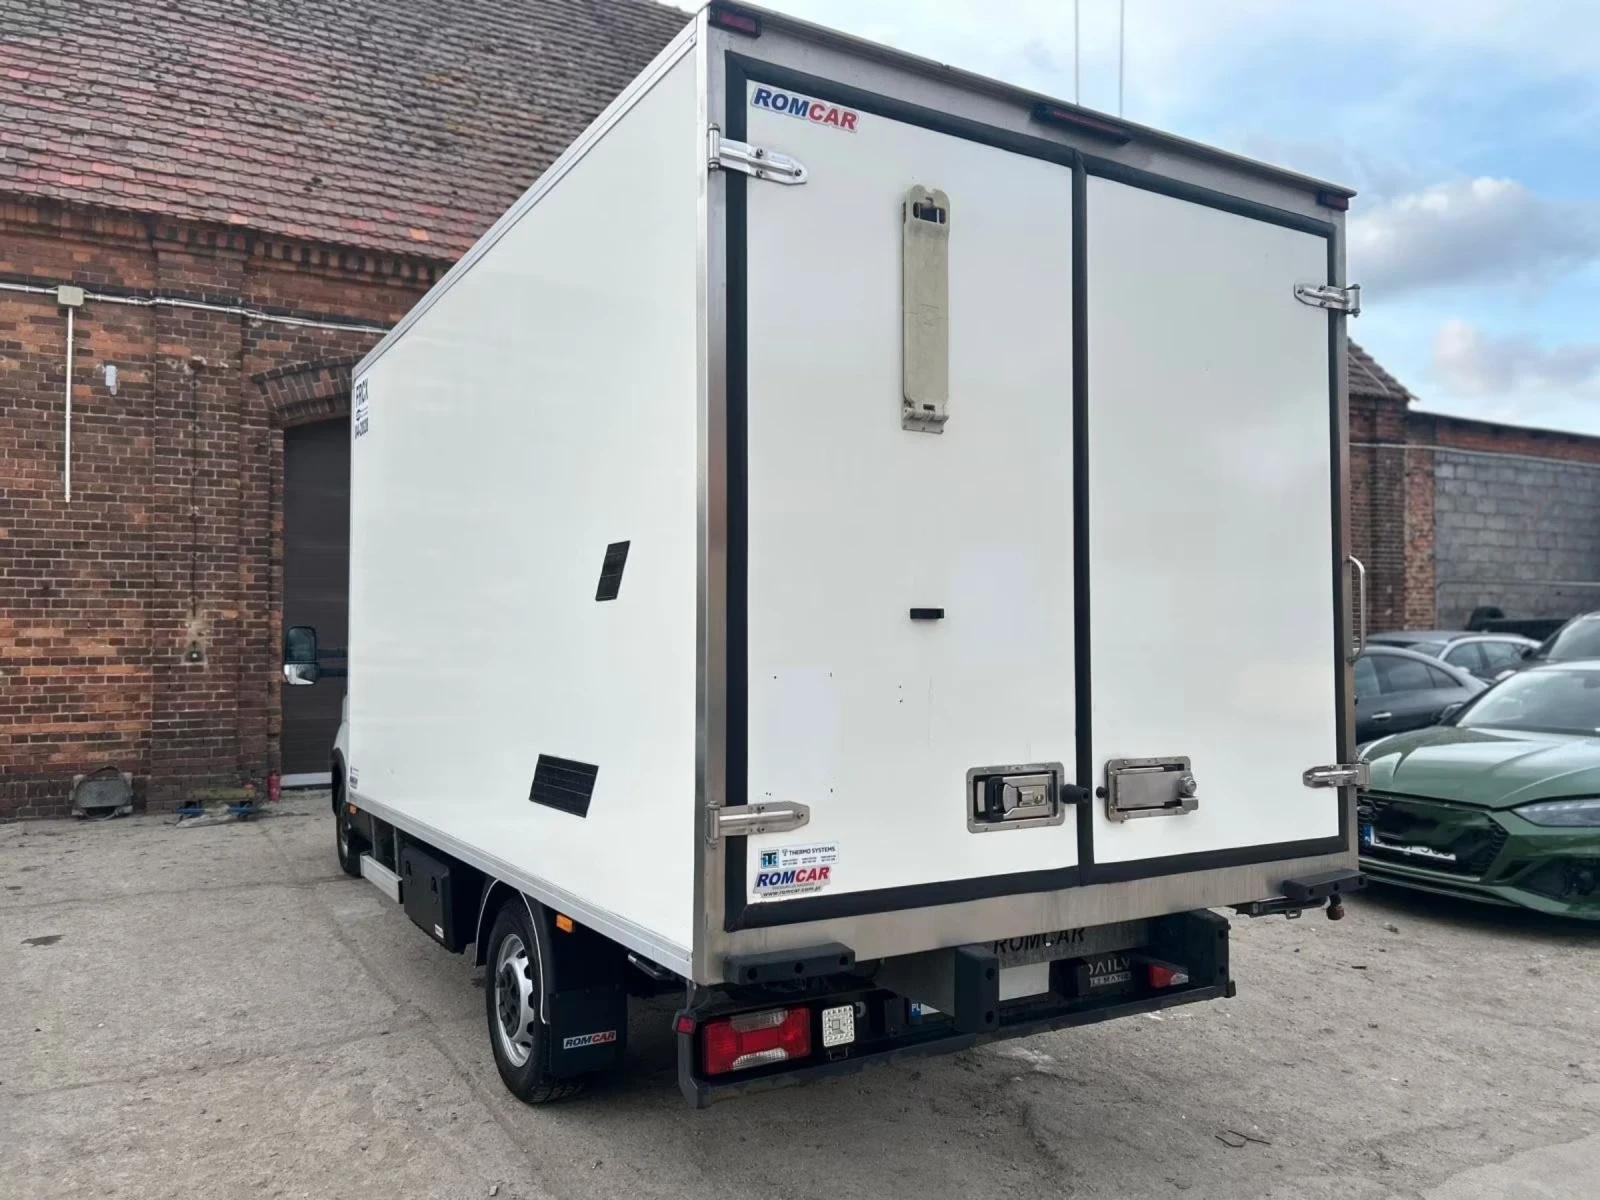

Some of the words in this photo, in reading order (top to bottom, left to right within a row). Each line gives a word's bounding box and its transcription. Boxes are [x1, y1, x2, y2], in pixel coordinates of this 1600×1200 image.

[754, 87, 857, 130] ROMCAR
[789, 848, 811, 856] THERMO
[812, 846, 836, 854] SYSTEMS
[756, 867, 830, 888] ROMCAR
[763, 885, 822, 897] www.romcar.com.pl
[993, 927, 1085, 954] ROMCAR
[911, 1003, 921, 1013] PL
[565, 1031, 616, 1048] ROMCAR
